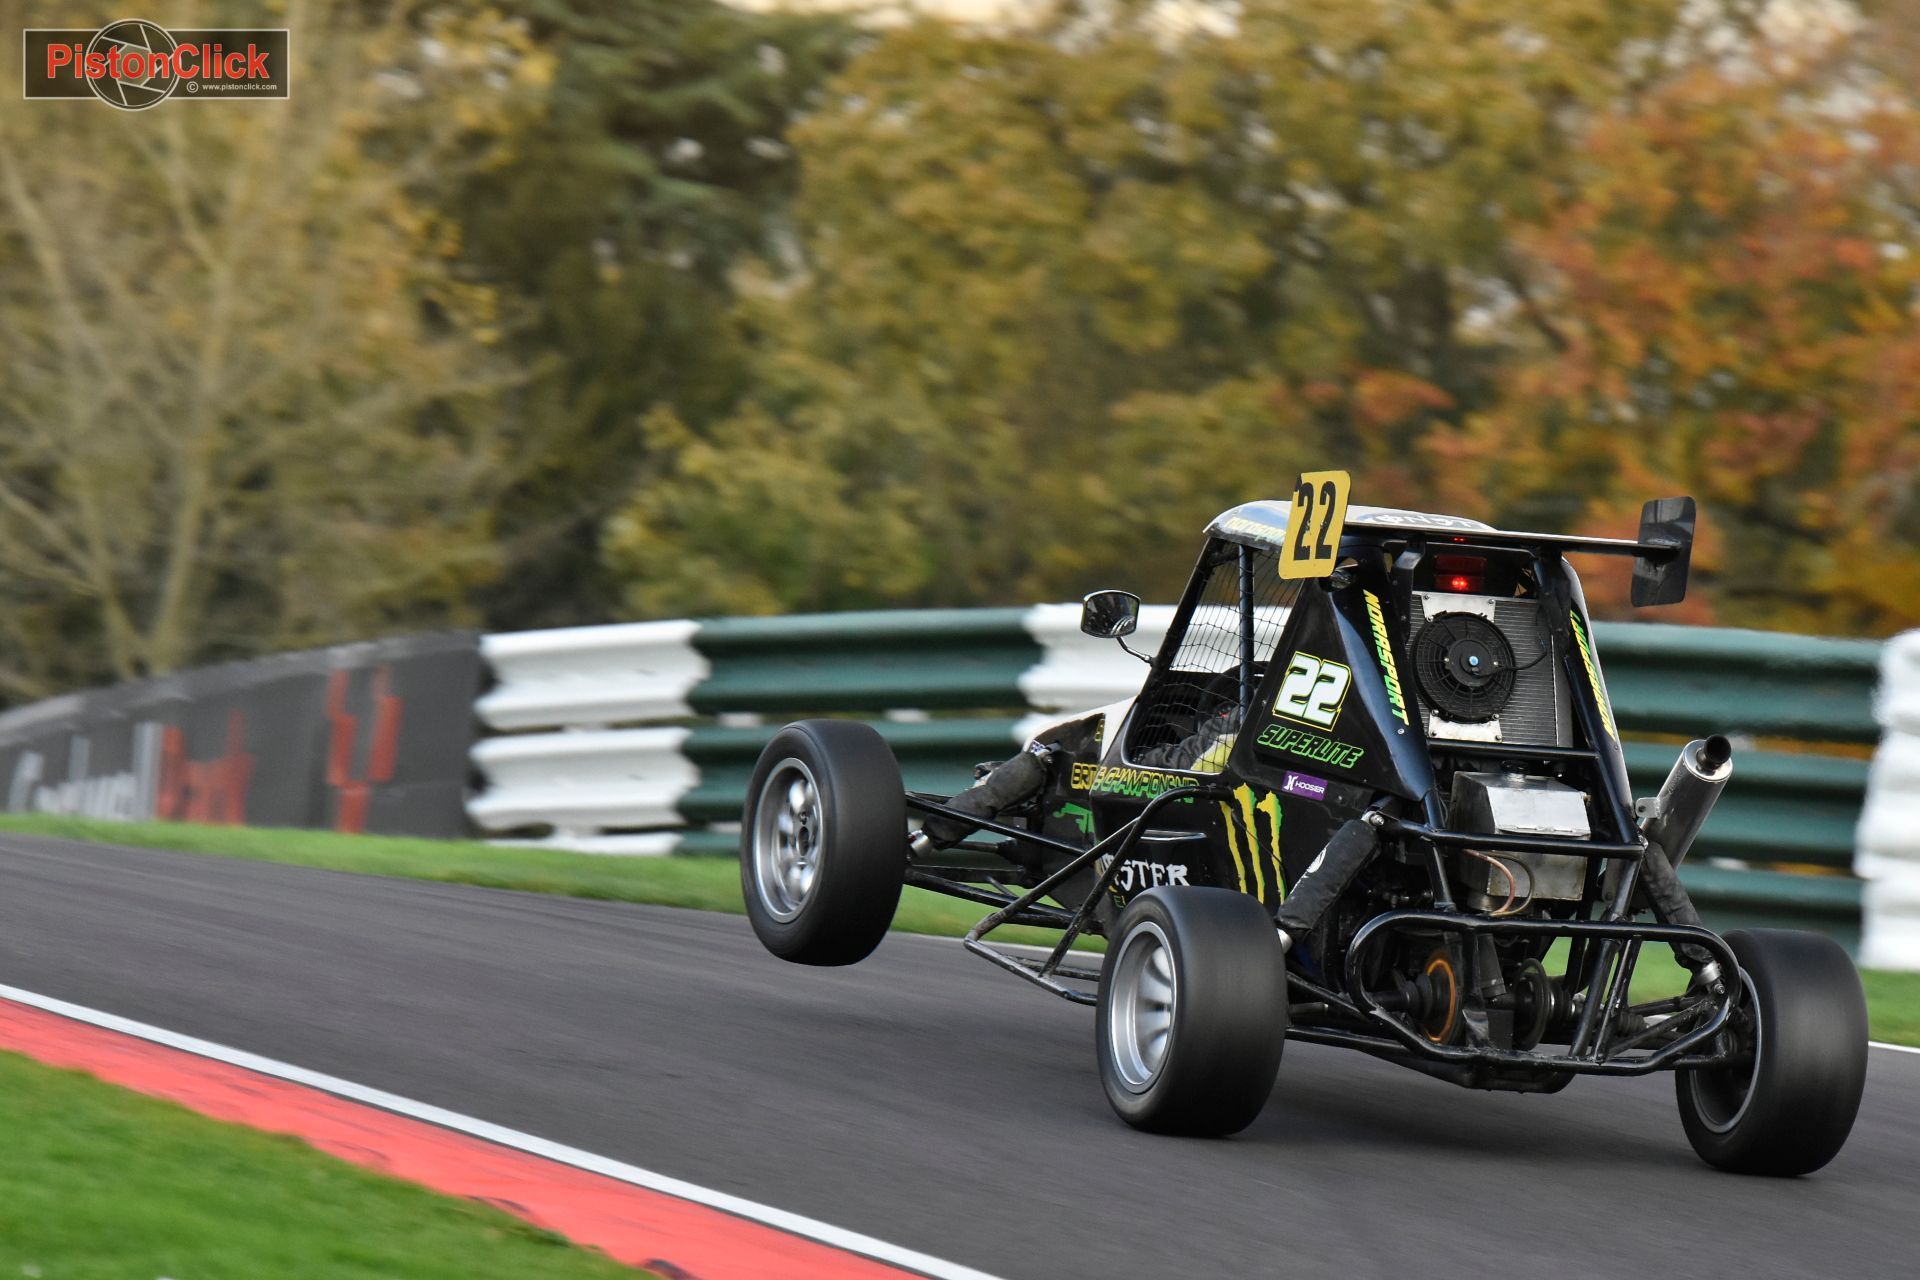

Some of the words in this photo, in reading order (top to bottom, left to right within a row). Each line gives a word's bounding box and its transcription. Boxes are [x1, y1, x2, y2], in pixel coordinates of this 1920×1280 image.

[1293, 480, 1336, 561] 22
[1272, 651, 1352, 732] 22
[1362, 588, 1410, 726] NORASPORT
[1256, 723, 1364, 769] SUPERLITE
[1294, 780, 1325, 794] HOOSIER
